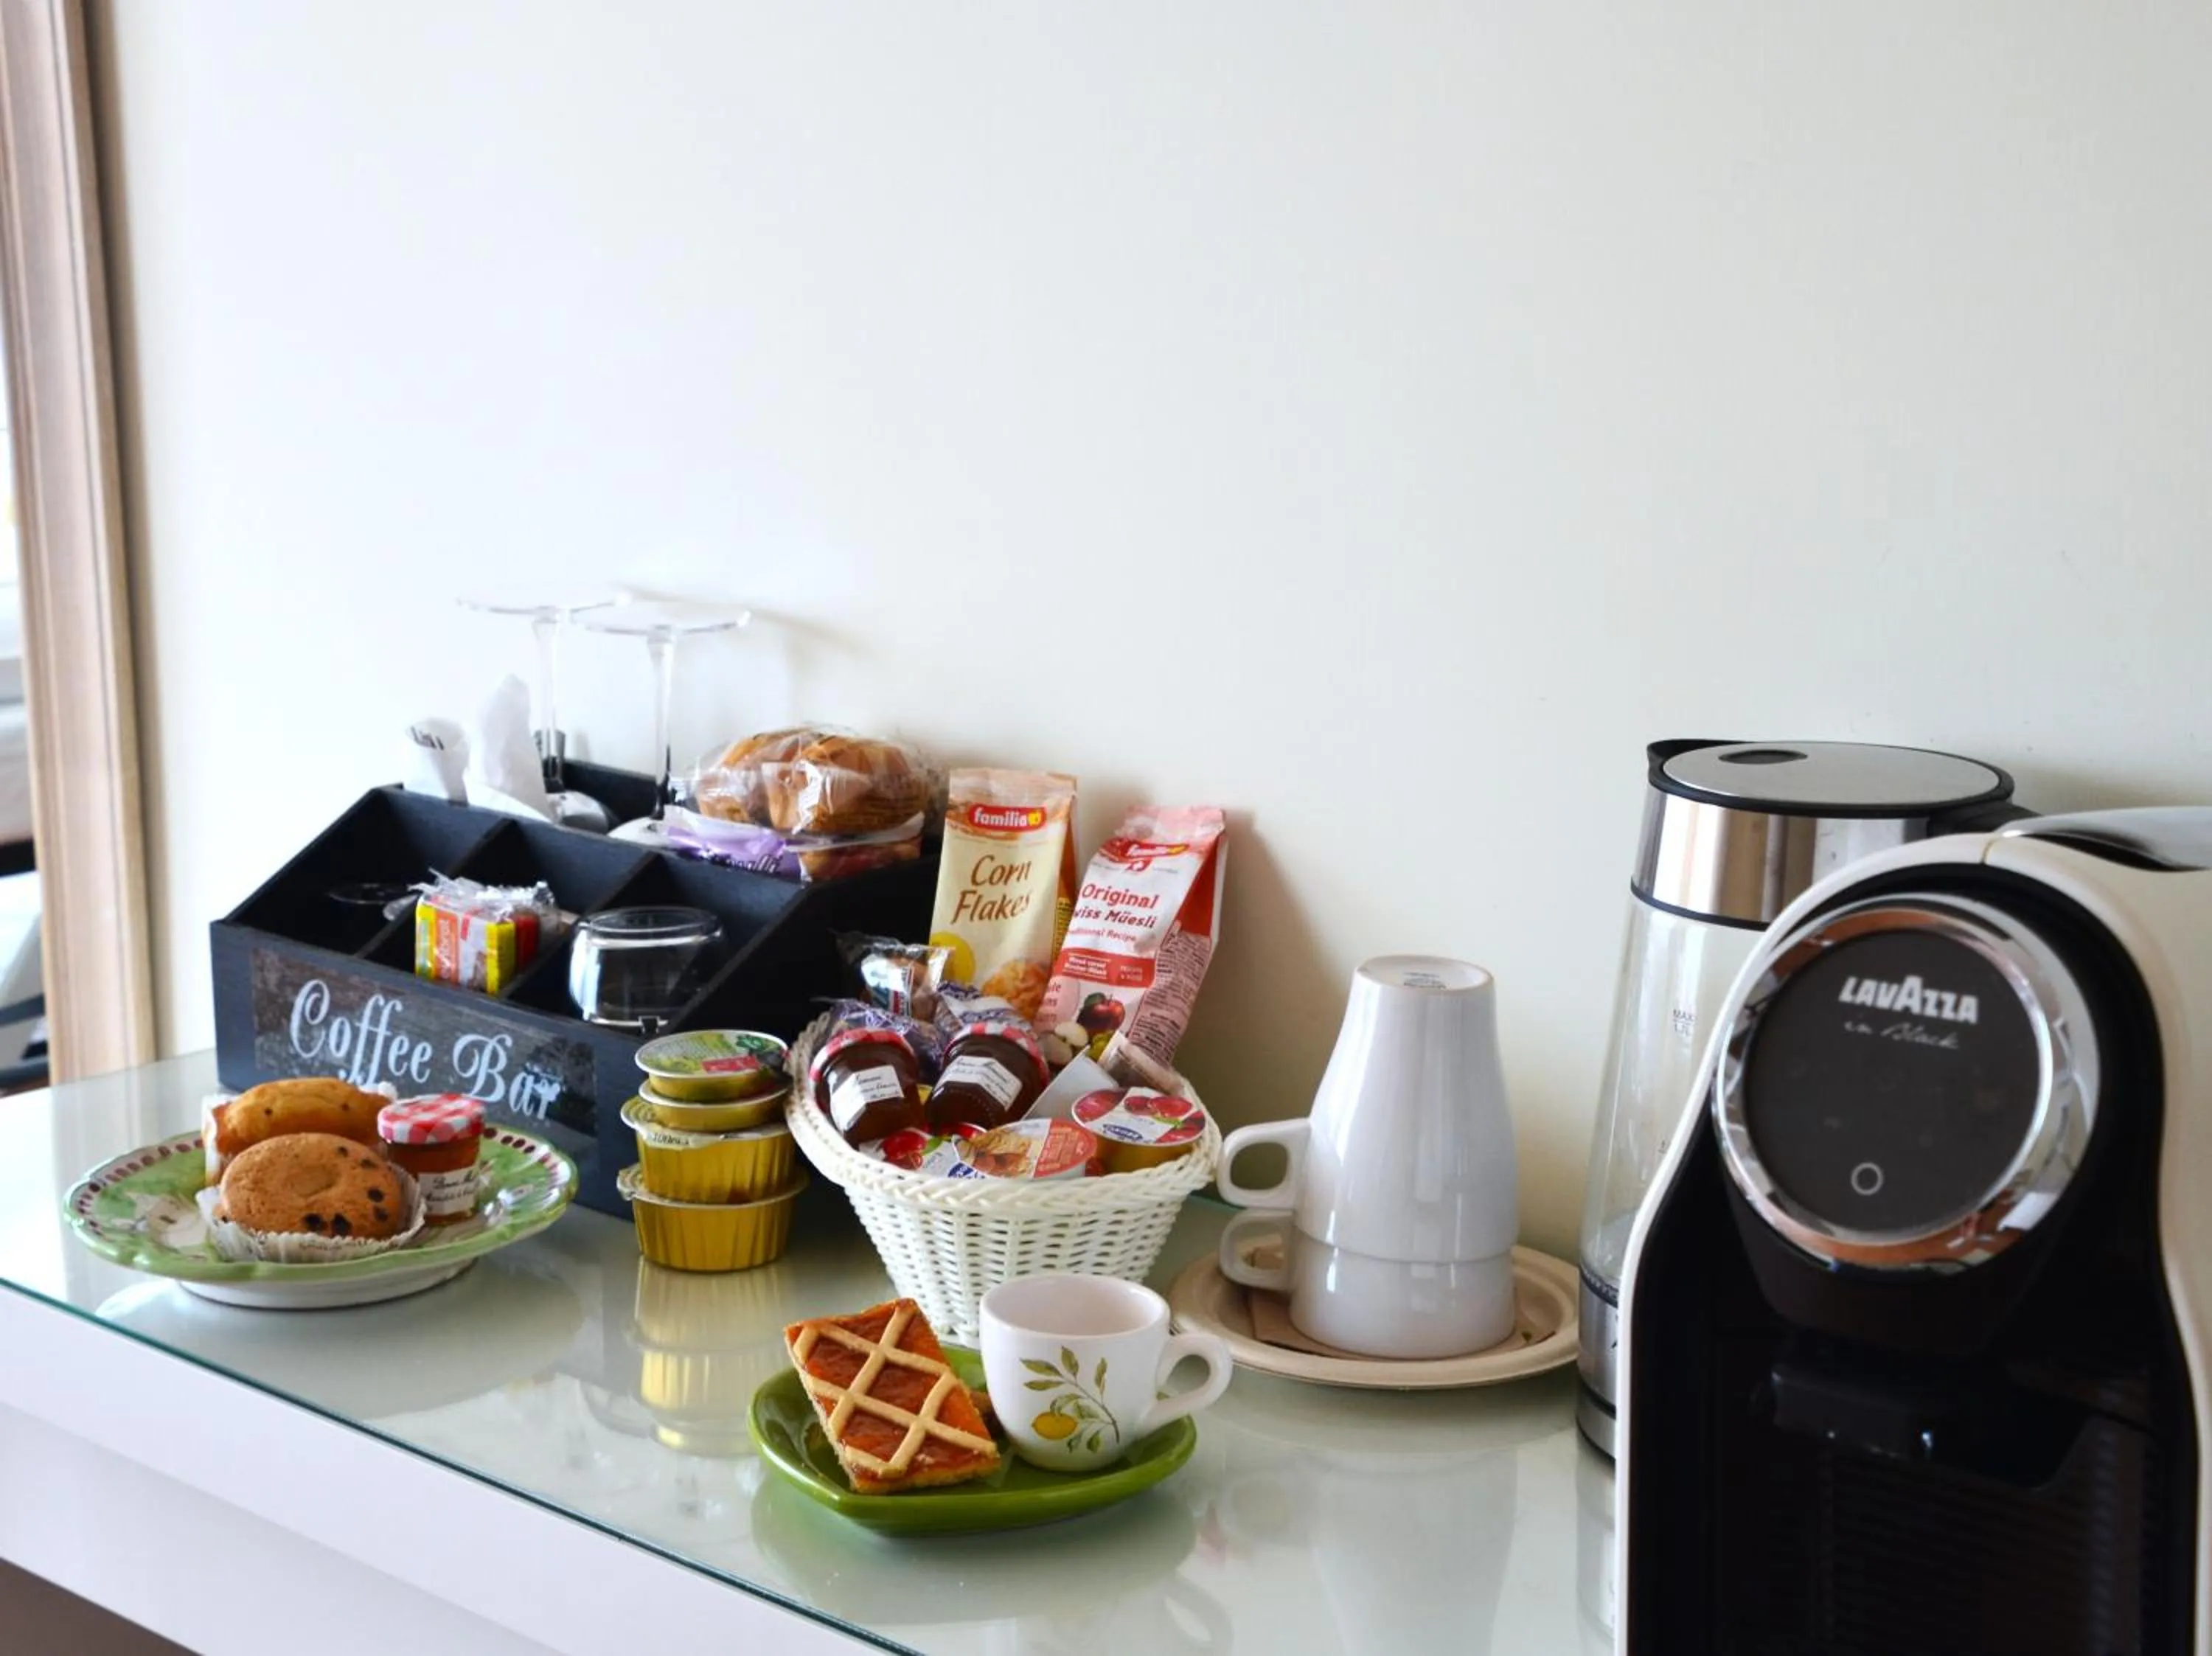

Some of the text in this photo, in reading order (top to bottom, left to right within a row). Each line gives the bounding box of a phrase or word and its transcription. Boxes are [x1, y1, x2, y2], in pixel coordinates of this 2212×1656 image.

[974, 807, 1027, 827] familia
[971, 855, 1032, 886] Corn
[950, 891, 1031, 924] Flakes
[1082, 883, 1160, 909] Original
[1104, 909, 1157, 928] Müesli
[1838, 975, 1979, 1025] LAVAZZA
[291, 979, 566, 1120] Coffee Bar
